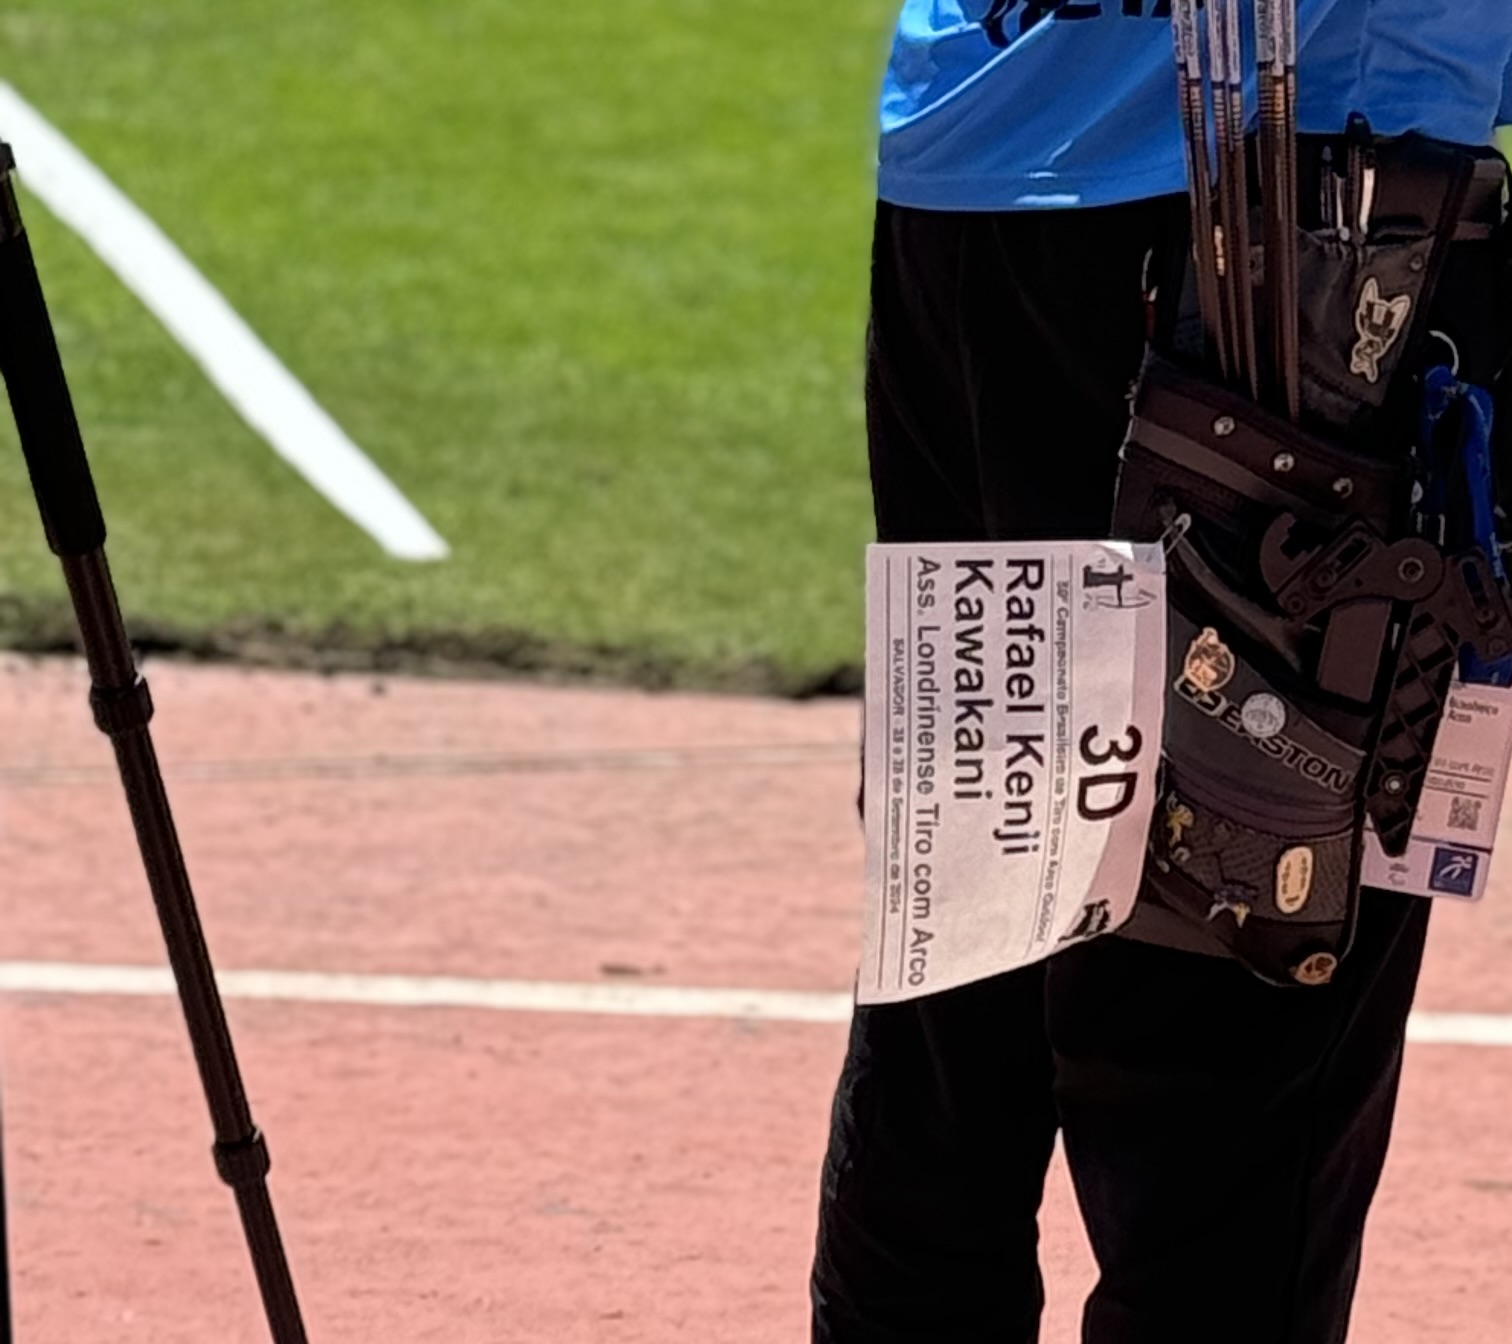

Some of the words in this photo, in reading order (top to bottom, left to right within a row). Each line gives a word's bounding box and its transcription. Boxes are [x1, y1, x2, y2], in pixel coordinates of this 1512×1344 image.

[916, 555, 942, 616] Ass.
[892, 638, 905, 716] SALVADOR
[953, 559, 995, 800] Kawakani
[1005, 558, 1046, 714] Rafael
[916, 625, 942, 796] Londrinense
[992, 734, 1046, 856] Kenji
[1077, 723, 1143, 822] 3D
[914, 802, 940, 856] Tiro
[912, 863, 932, 921] com
[907, 927, 935, 987] Arco
